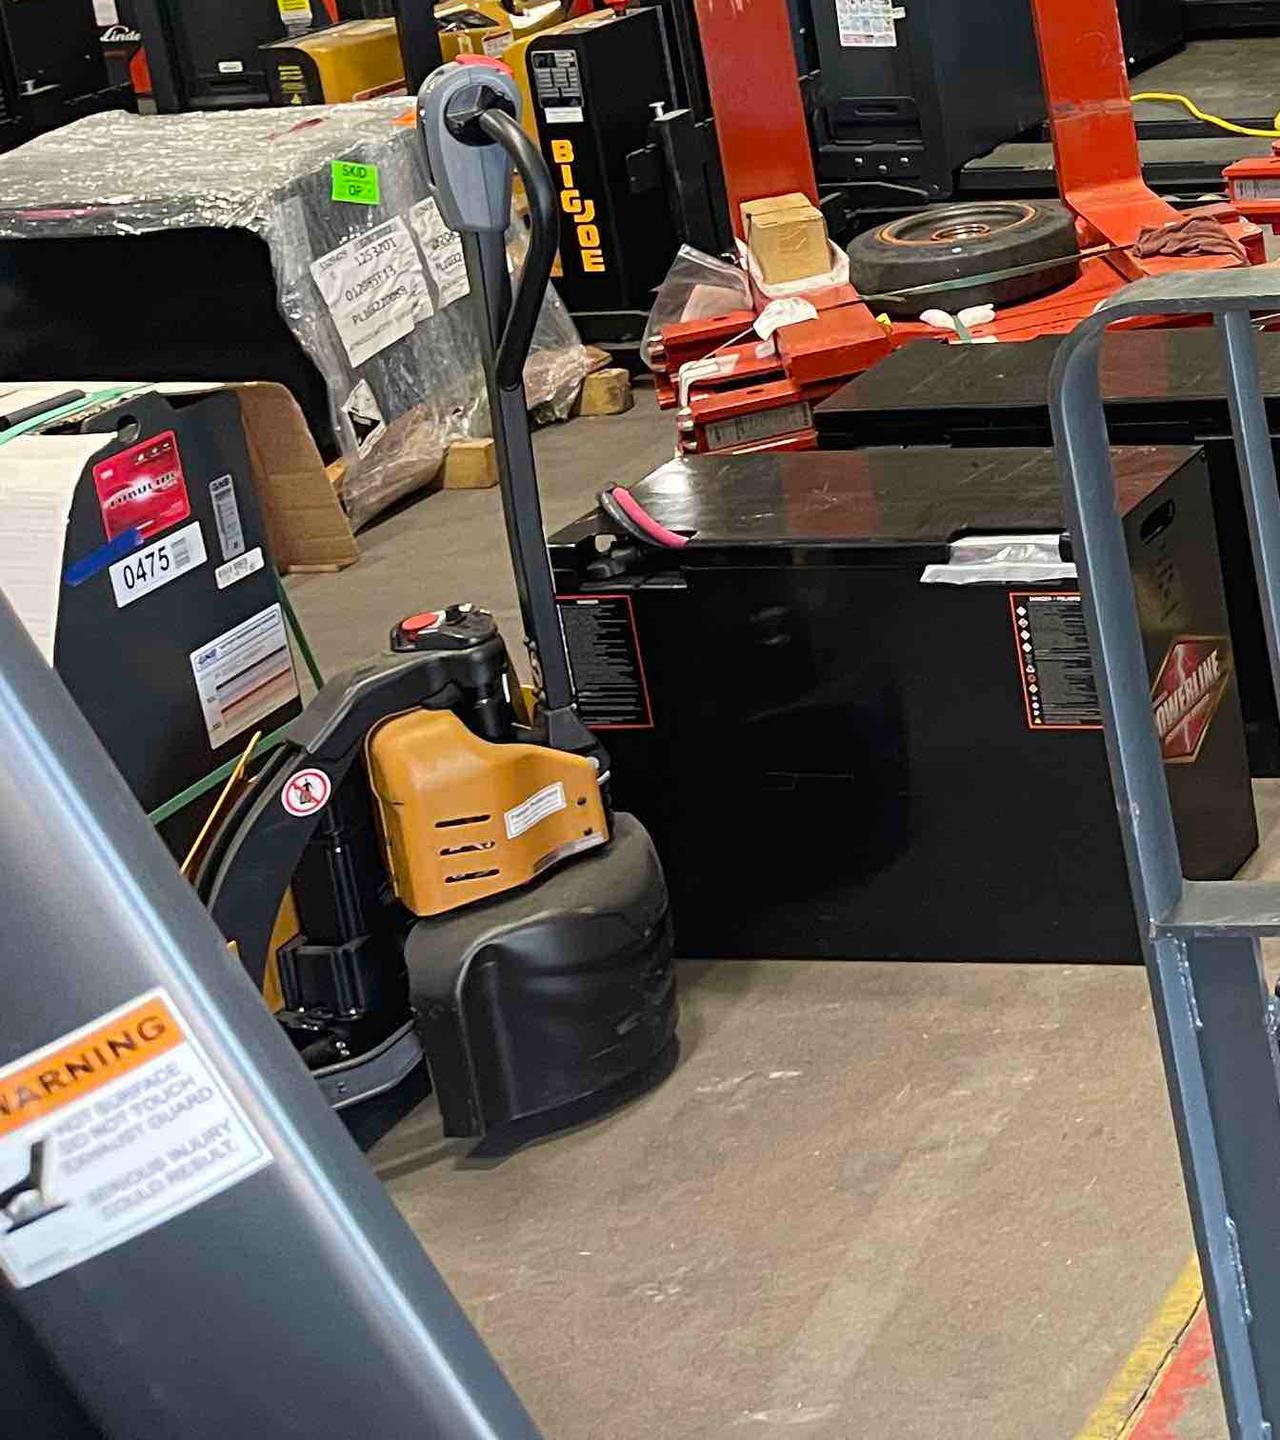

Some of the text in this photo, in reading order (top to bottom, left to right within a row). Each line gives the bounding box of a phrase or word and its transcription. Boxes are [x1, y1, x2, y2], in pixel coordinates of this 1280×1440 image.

[100, 25, 143, 43] Linde
[341, 166, 368, 180] SKID
[122, 545, 170, 590] 0475
[1154, 647, 1222, 738] OWERLINE
